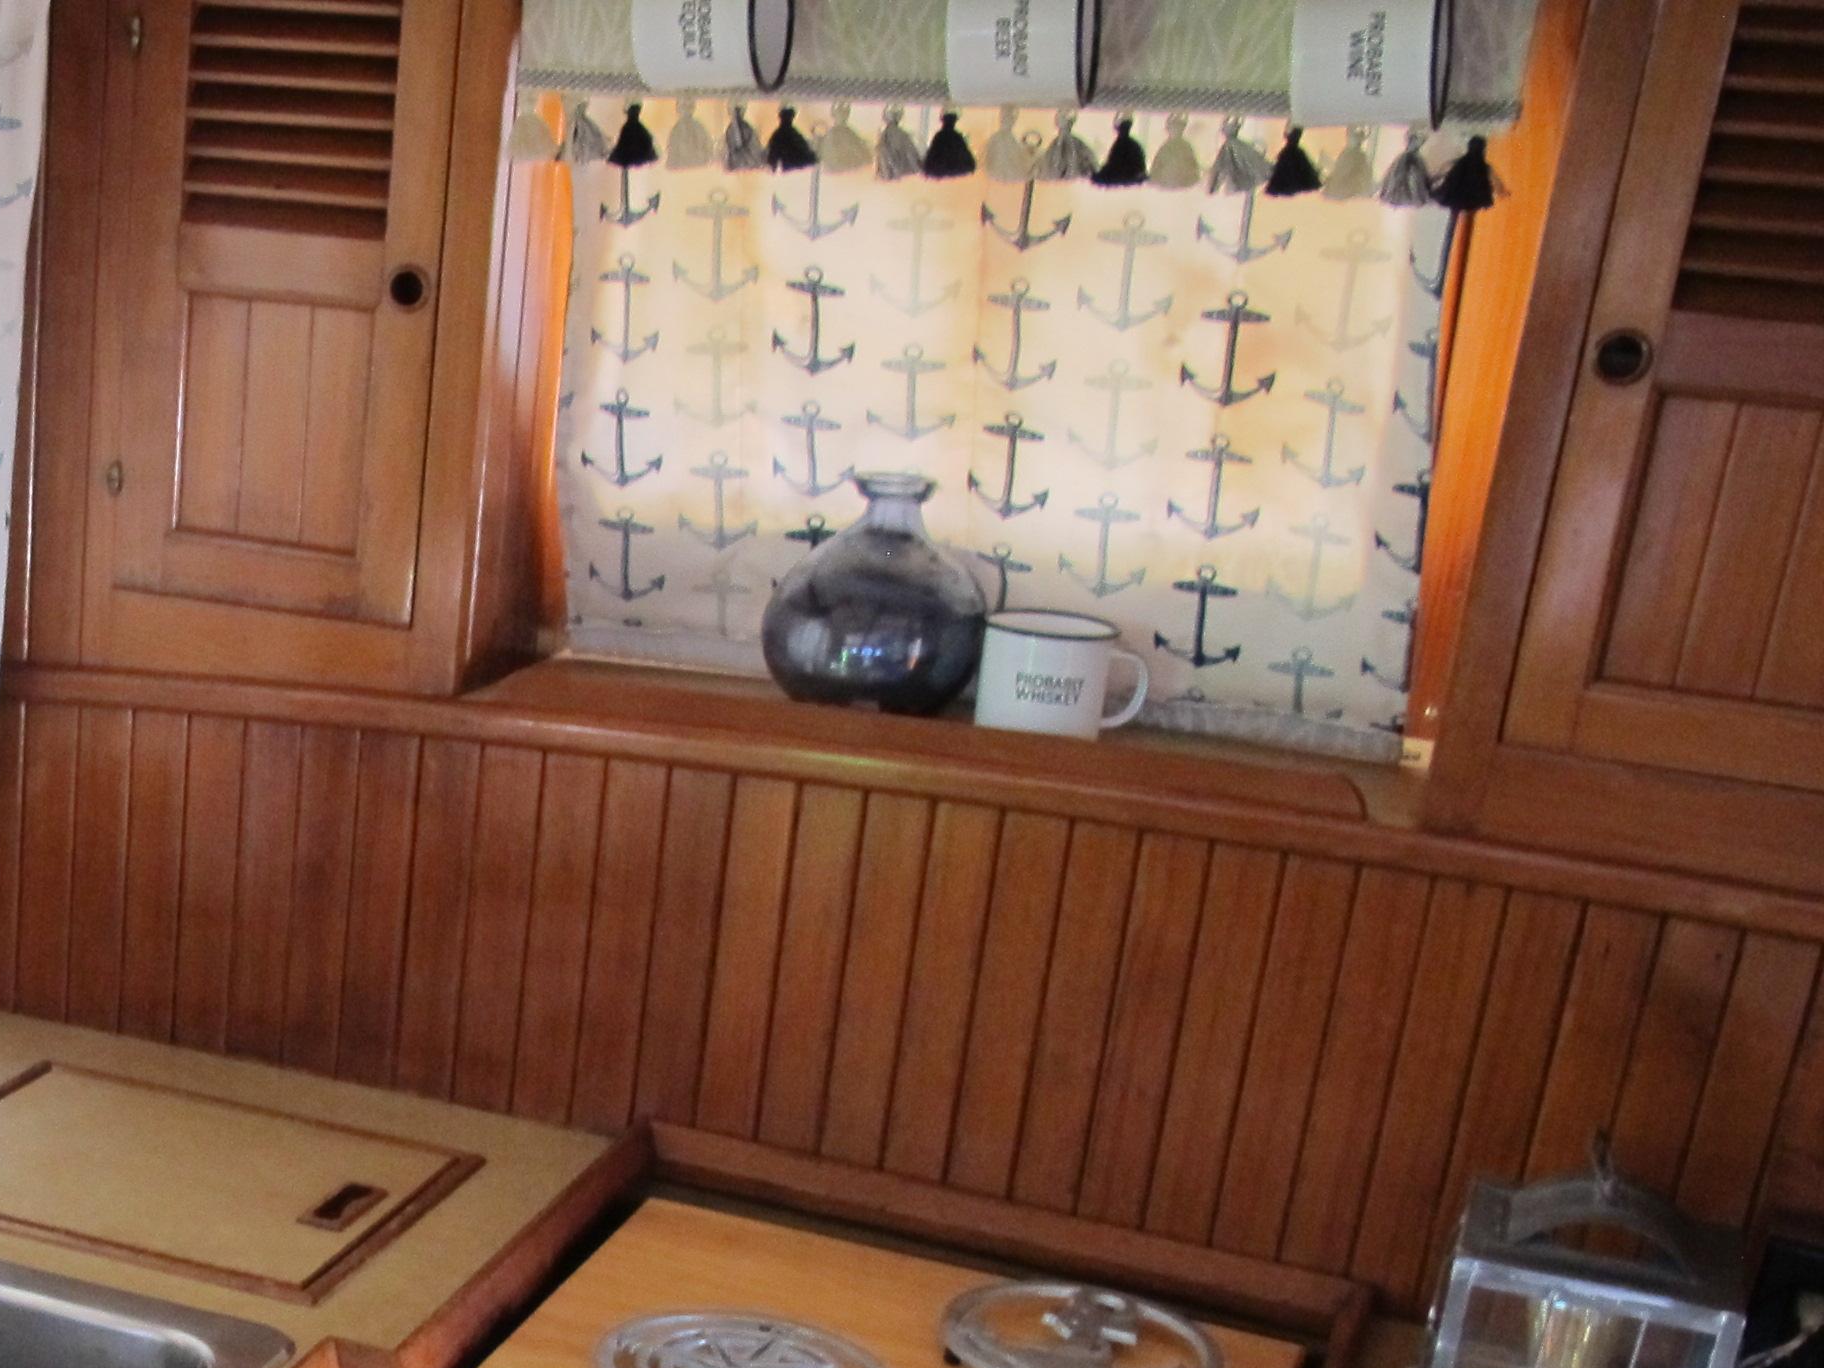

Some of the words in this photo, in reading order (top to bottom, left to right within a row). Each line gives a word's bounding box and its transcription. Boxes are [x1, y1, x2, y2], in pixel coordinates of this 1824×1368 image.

[697, 0, 713, 60] OBABLY
[995, 17, 1011, 60] BEER
[1346, 29, 1366, 81] WINE
[1365, 11, 1386, 95] PROBABLY
[1015, 671, 1085, 690] PROBABLY
